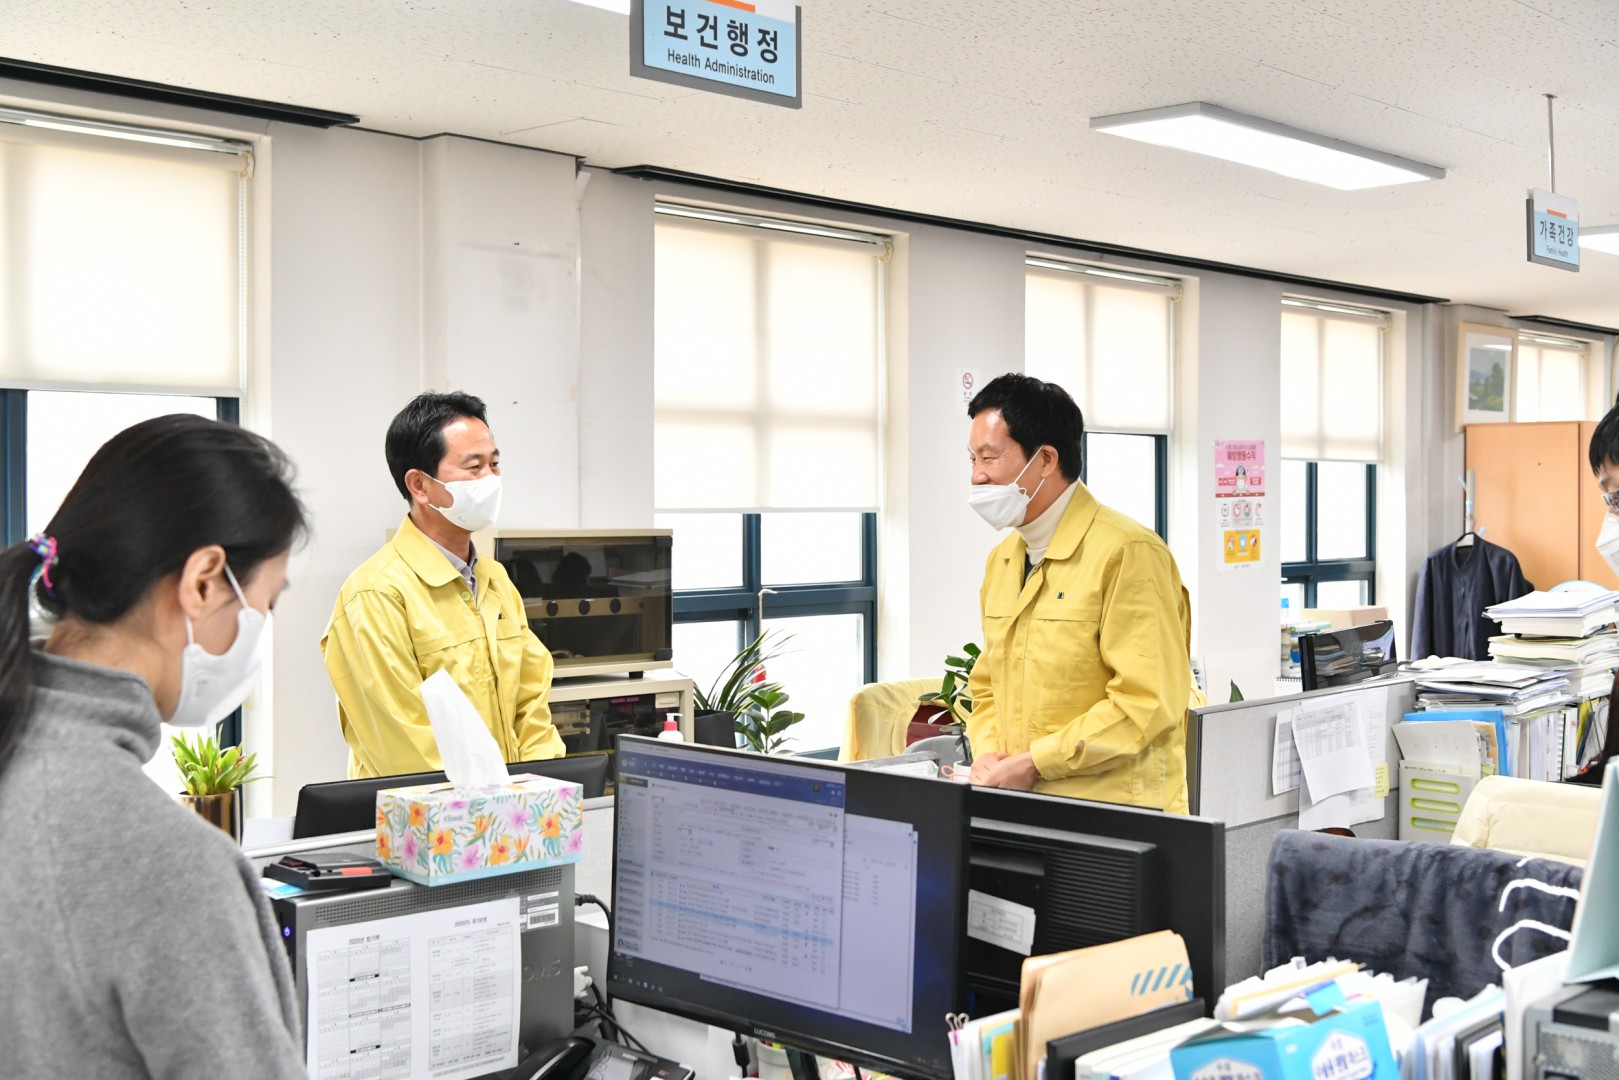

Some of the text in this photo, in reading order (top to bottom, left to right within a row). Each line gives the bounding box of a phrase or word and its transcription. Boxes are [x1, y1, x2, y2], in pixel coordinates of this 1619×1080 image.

[663, 5, 779, 64] 보건행정
[667, 48, 776, 85] Health Administration
[1540, 220, 1574, 248] 가족건강
